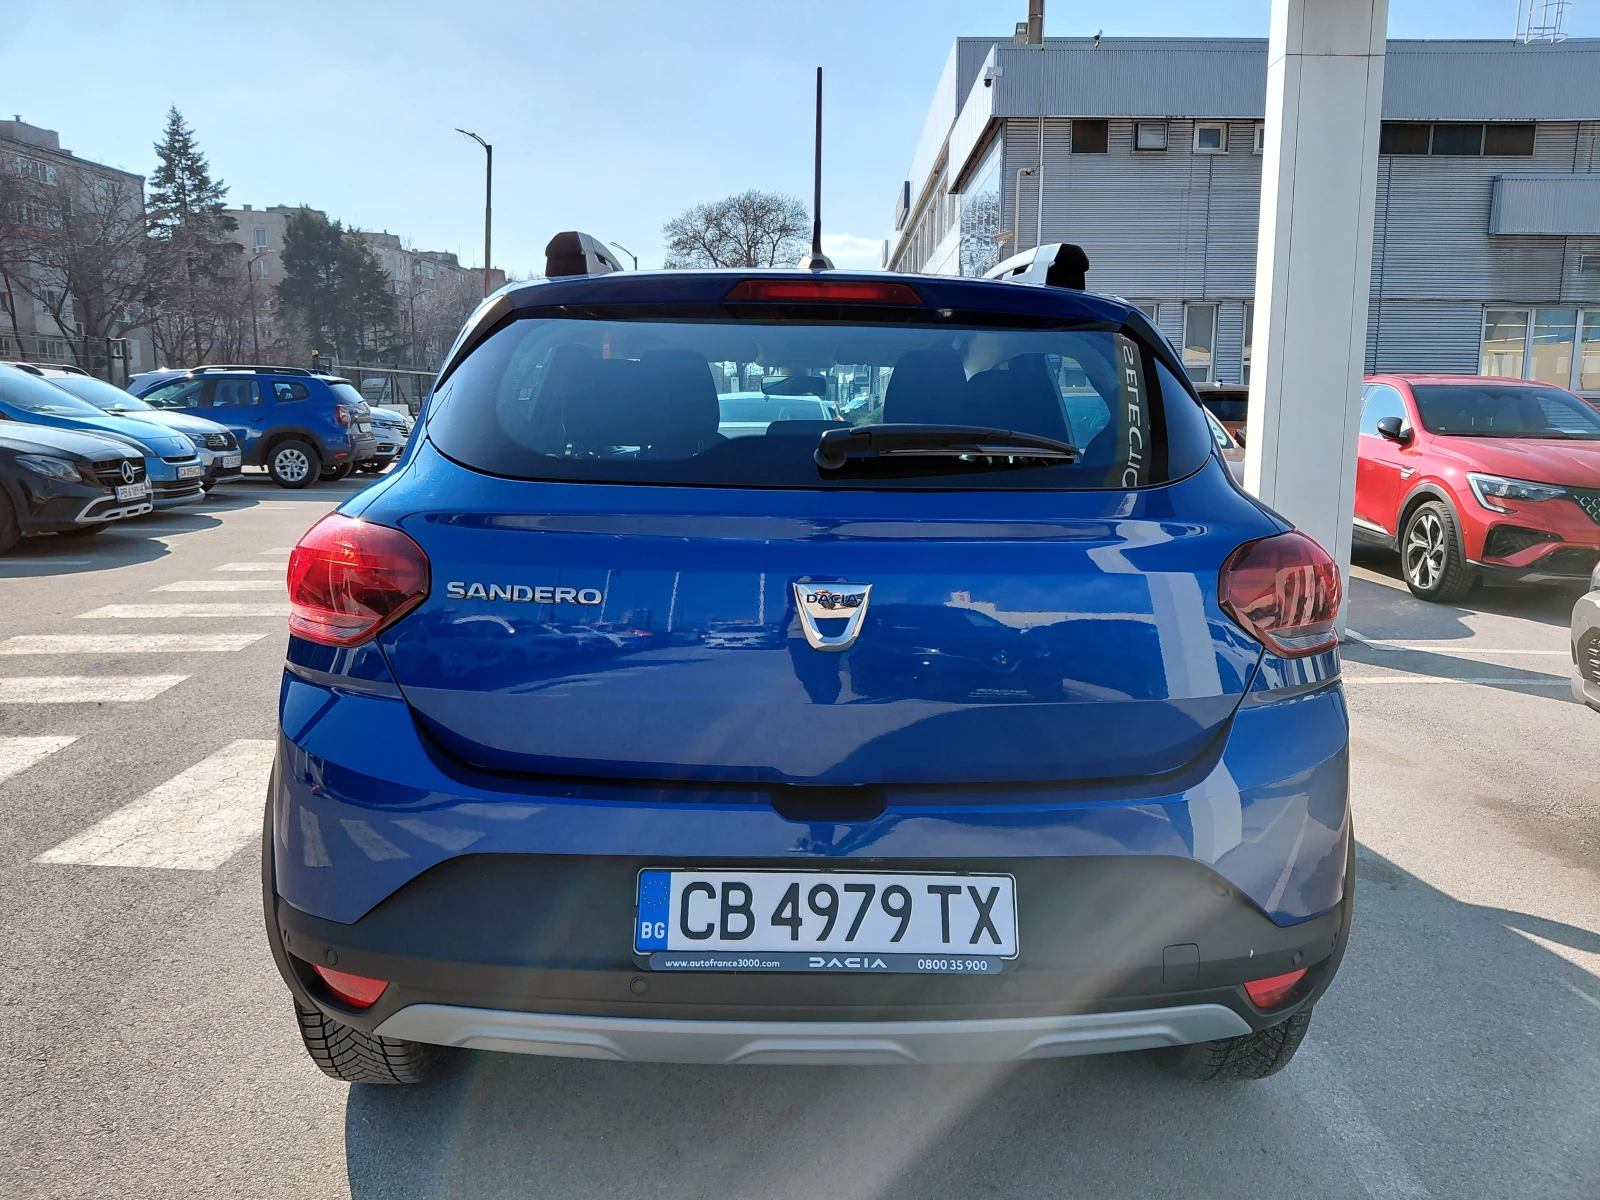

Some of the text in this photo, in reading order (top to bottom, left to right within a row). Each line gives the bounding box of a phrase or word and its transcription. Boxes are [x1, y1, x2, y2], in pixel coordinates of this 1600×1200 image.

[447, 581, 603, 605] SANDERO
[806, 594, 858, 604] DACIA
[680, 881, 1003, 945] CB 4979 TX
[641, 922, 665, 939] BG
[665, 958, 780, 969] www.autofrance3000.com
[808, 957, 888, 969] DACIA
[917, 958, 988, 971] 0800 35 900
